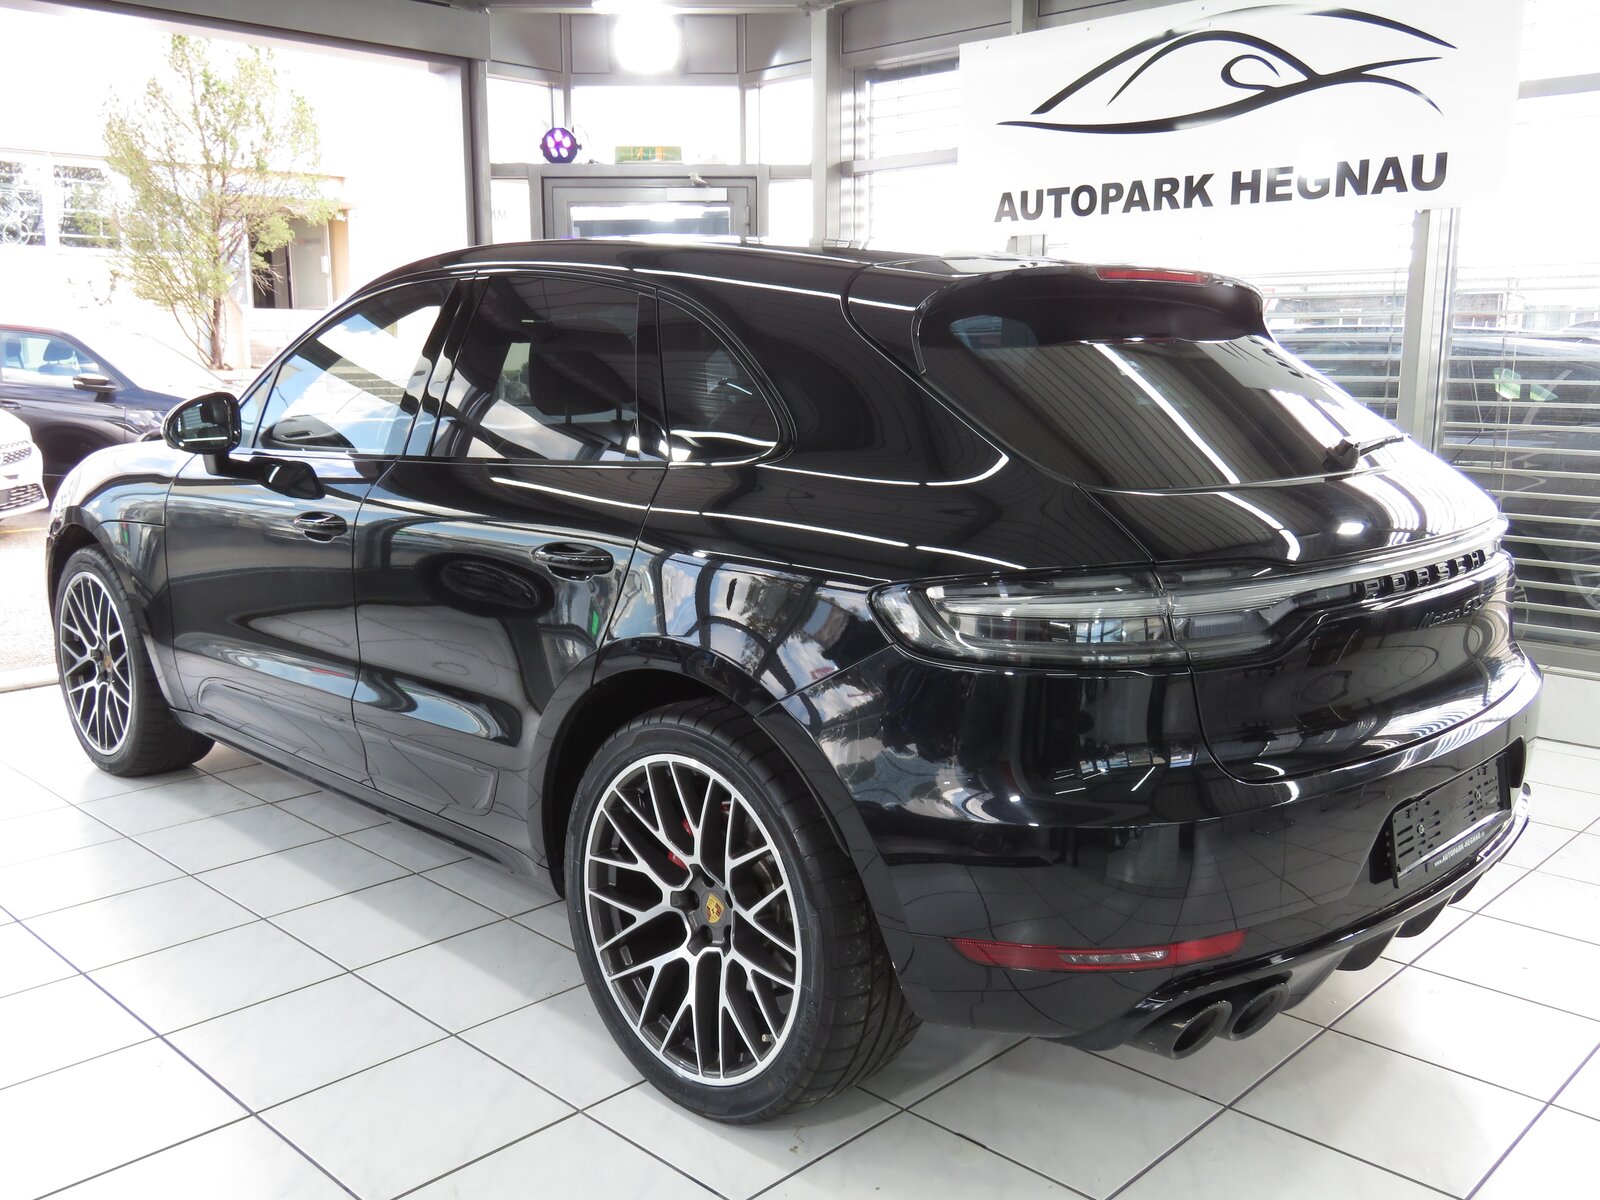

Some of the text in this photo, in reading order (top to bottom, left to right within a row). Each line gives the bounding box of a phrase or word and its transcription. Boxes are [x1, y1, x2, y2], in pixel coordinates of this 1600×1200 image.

[994, 152, 1448, 222] AUTOPARK HEGNAU
[1363, 550, 1488, 599] PORSCH
